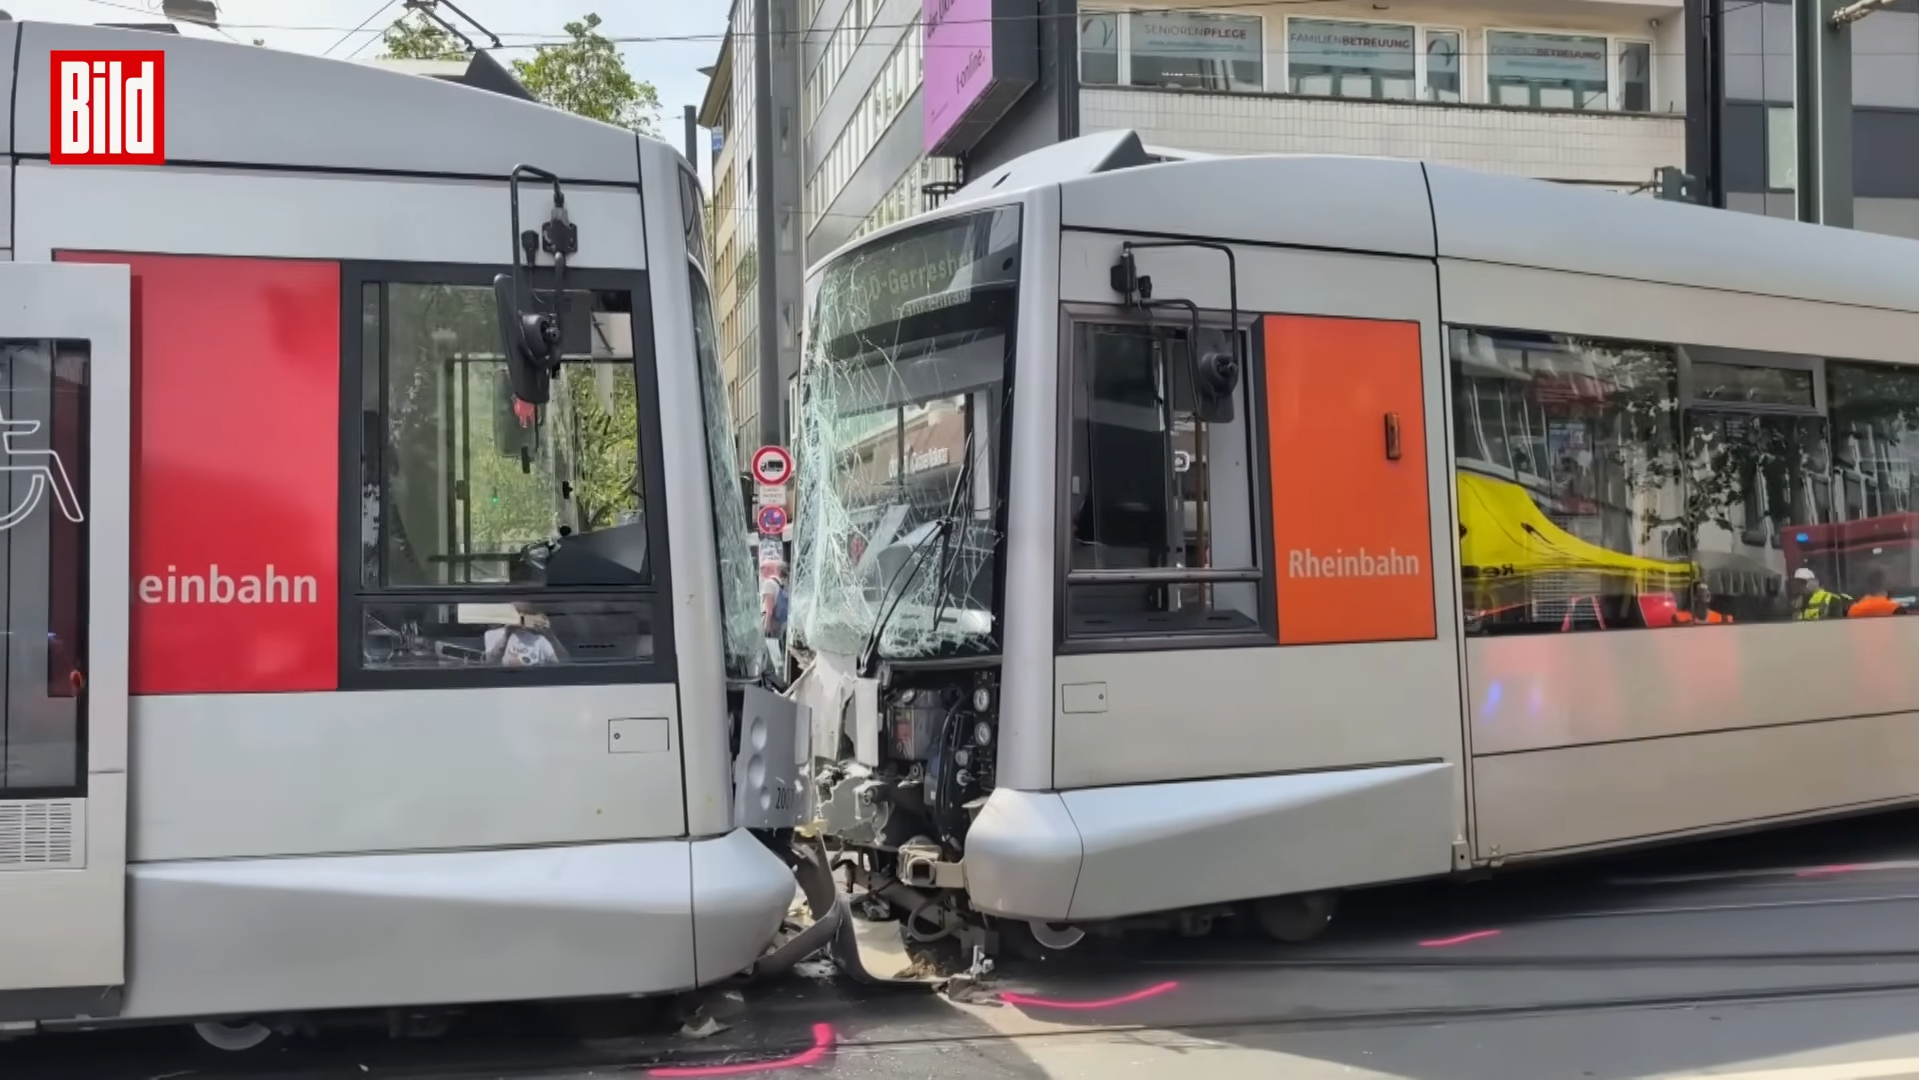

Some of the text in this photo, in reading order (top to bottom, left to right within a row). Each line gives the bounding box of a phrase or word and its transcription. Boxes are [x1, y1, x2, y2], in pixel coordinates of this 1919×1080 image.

[1144, 23, 1247, 41] SENIORENPFLEGE
[1290, 32, 1411, 49] FAMILIENBETREUUNG
[1288, 547, 1420, 579] Rheinbahn
[139, 563, 318, 604] einbahn
